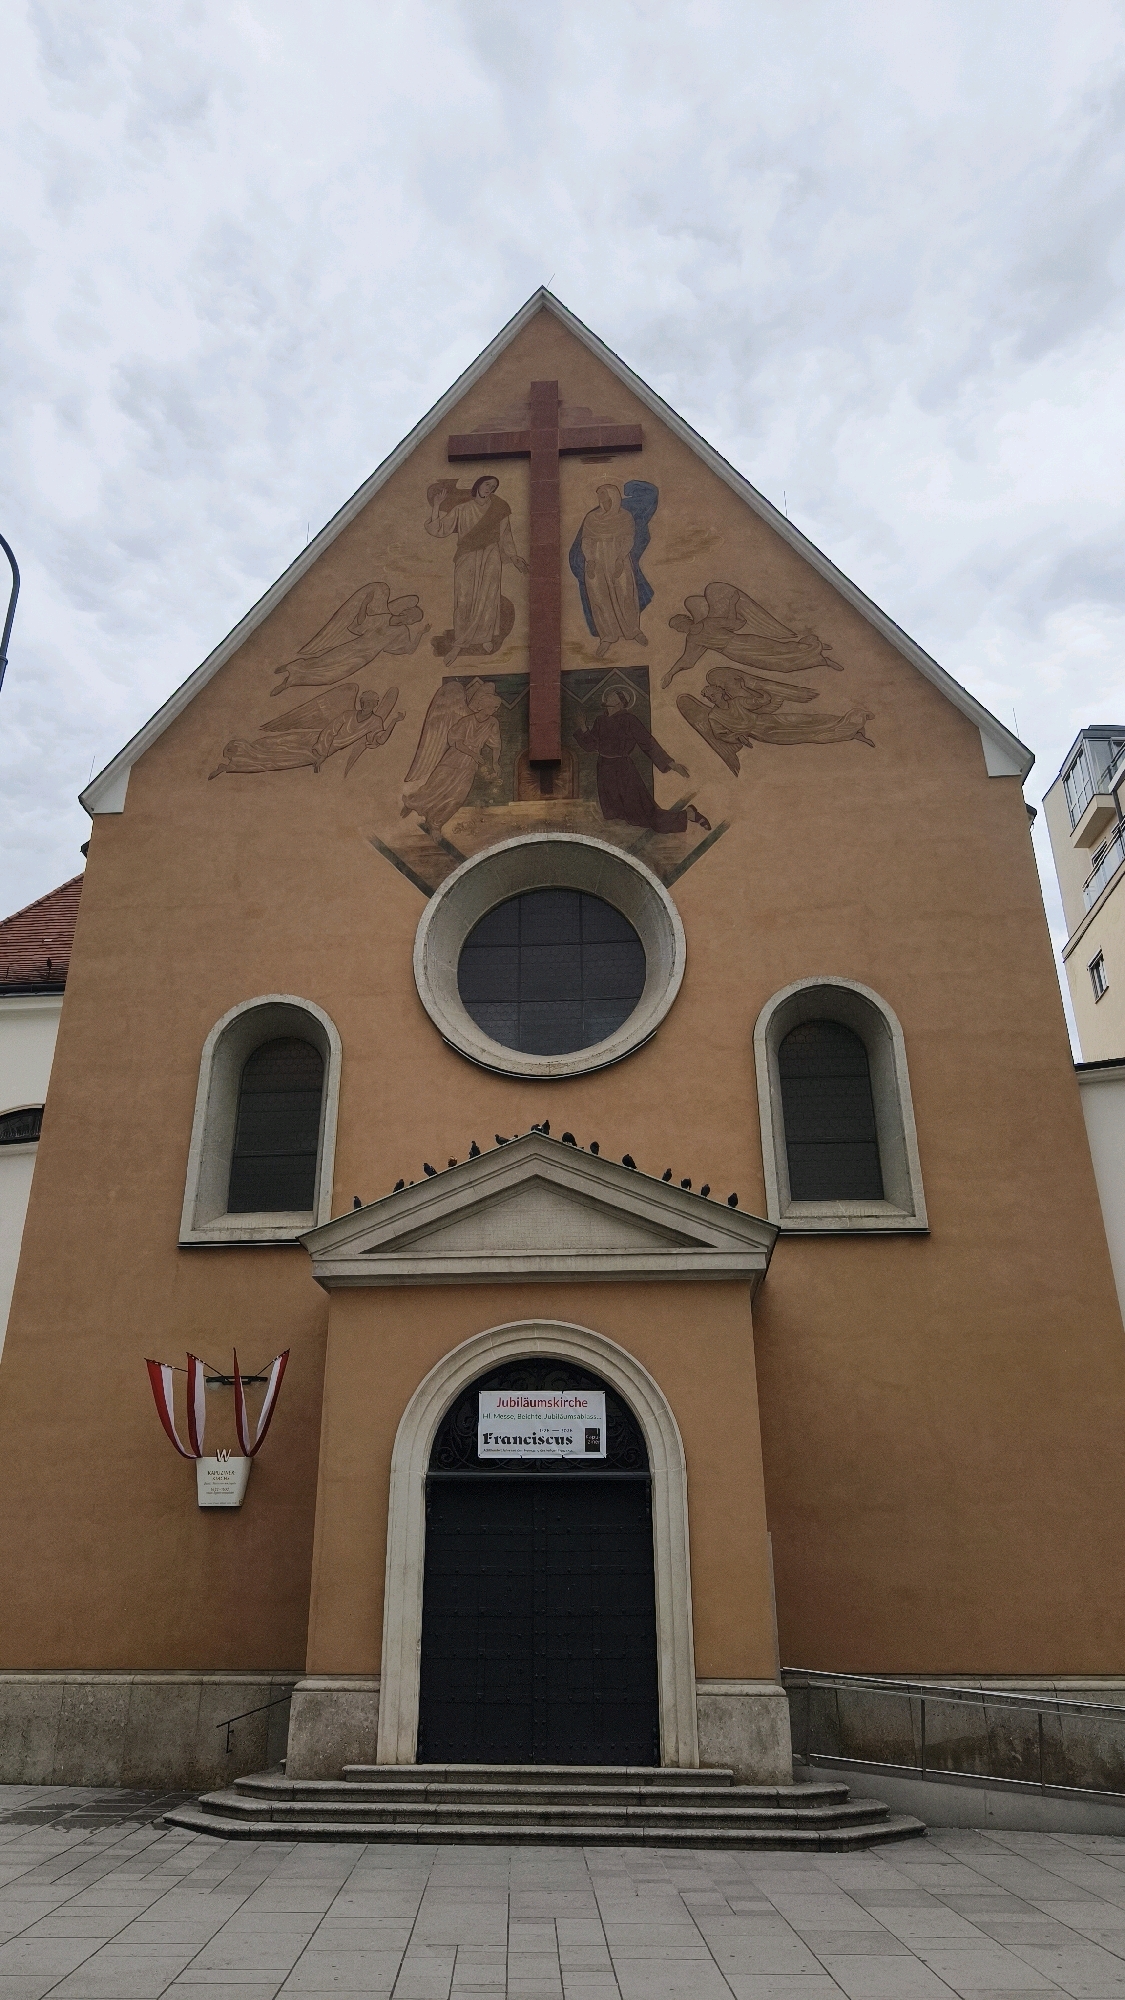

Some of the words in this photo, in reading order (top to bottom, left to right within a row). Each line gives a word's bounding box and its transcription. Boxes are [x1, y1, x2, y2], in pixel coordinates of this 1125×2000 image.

[496, 1396, 588, 1408] Jubiläumskirche
[482, 1432, 573, 1446] Franciscus
[216, 1448, 231, 1462] W
